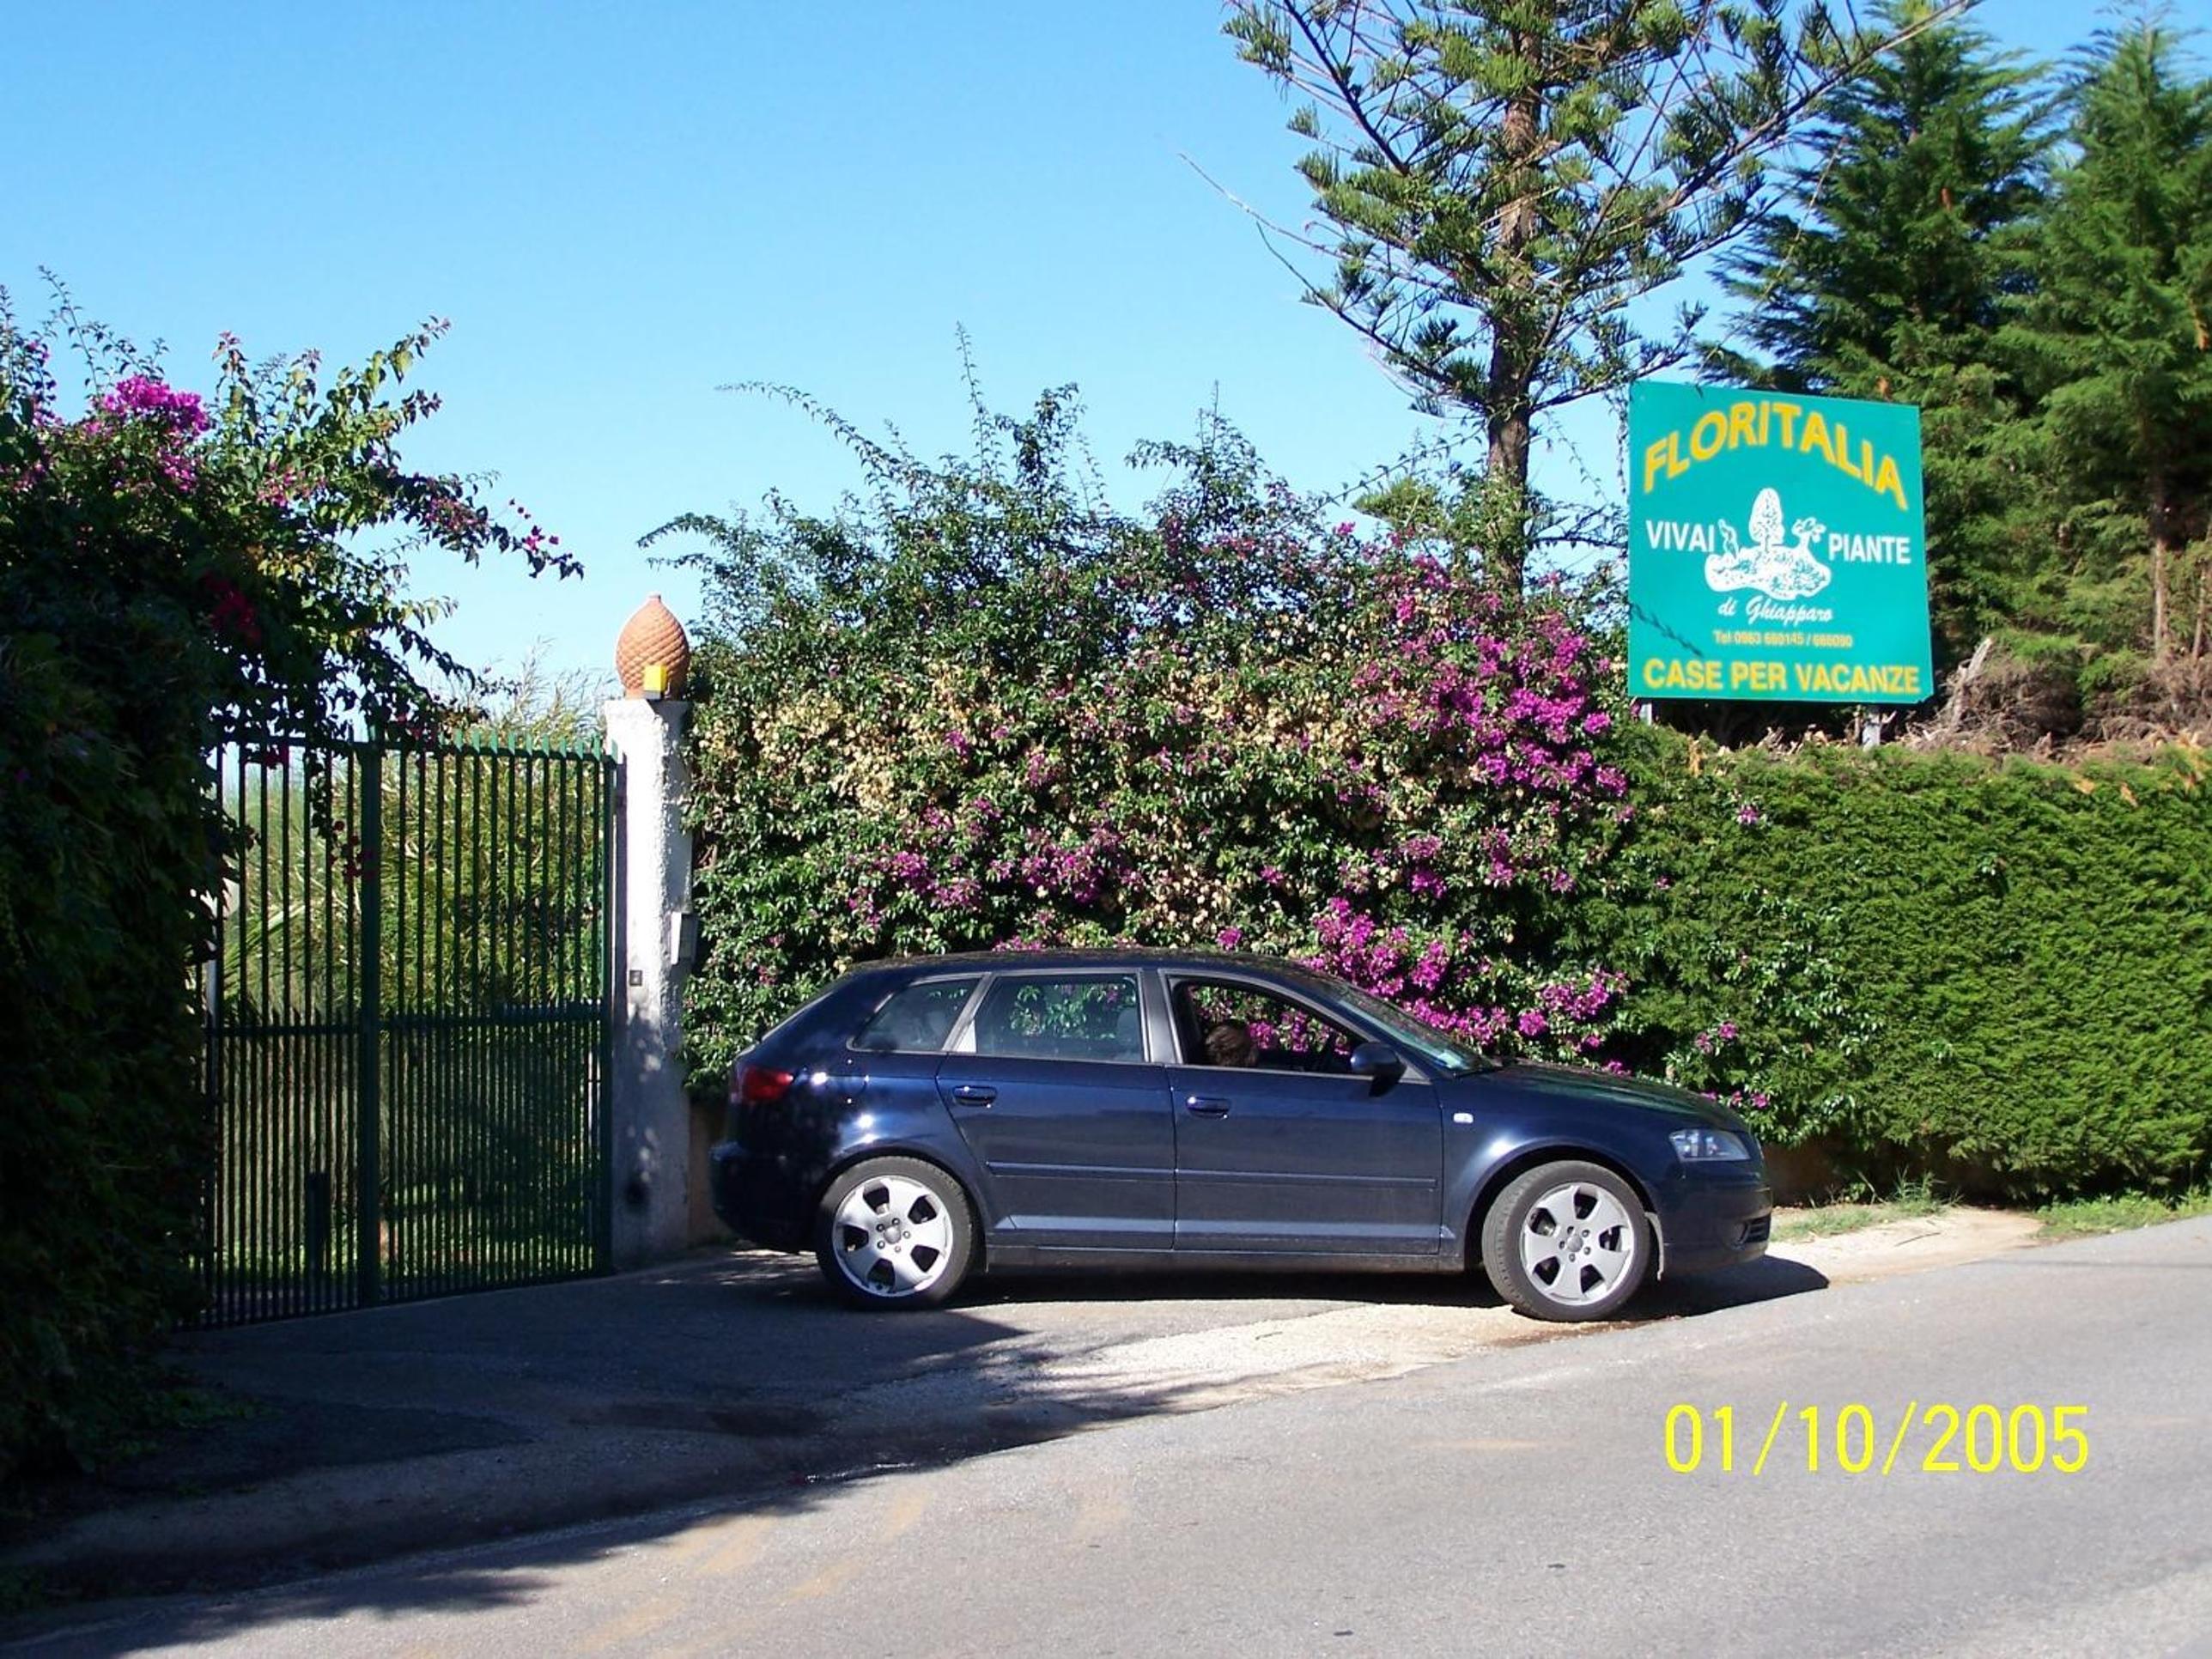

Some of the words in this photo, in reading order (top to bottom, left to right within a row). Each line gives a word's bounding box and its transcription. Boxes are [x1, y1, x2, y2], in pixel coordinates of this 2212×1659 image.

[1643, 400, 1909, 511] FLORITALIA
[1645, 520, 1715, 553] VIVAI
[1828, 532, 1912, 565] PIANTE
[1717, 596, 1737, 617] di
[1643, 658, 1722, 690] CASE
[1730, 660, 1788, 692] PER
[1796, 663, 1921, 694] VACANZE
